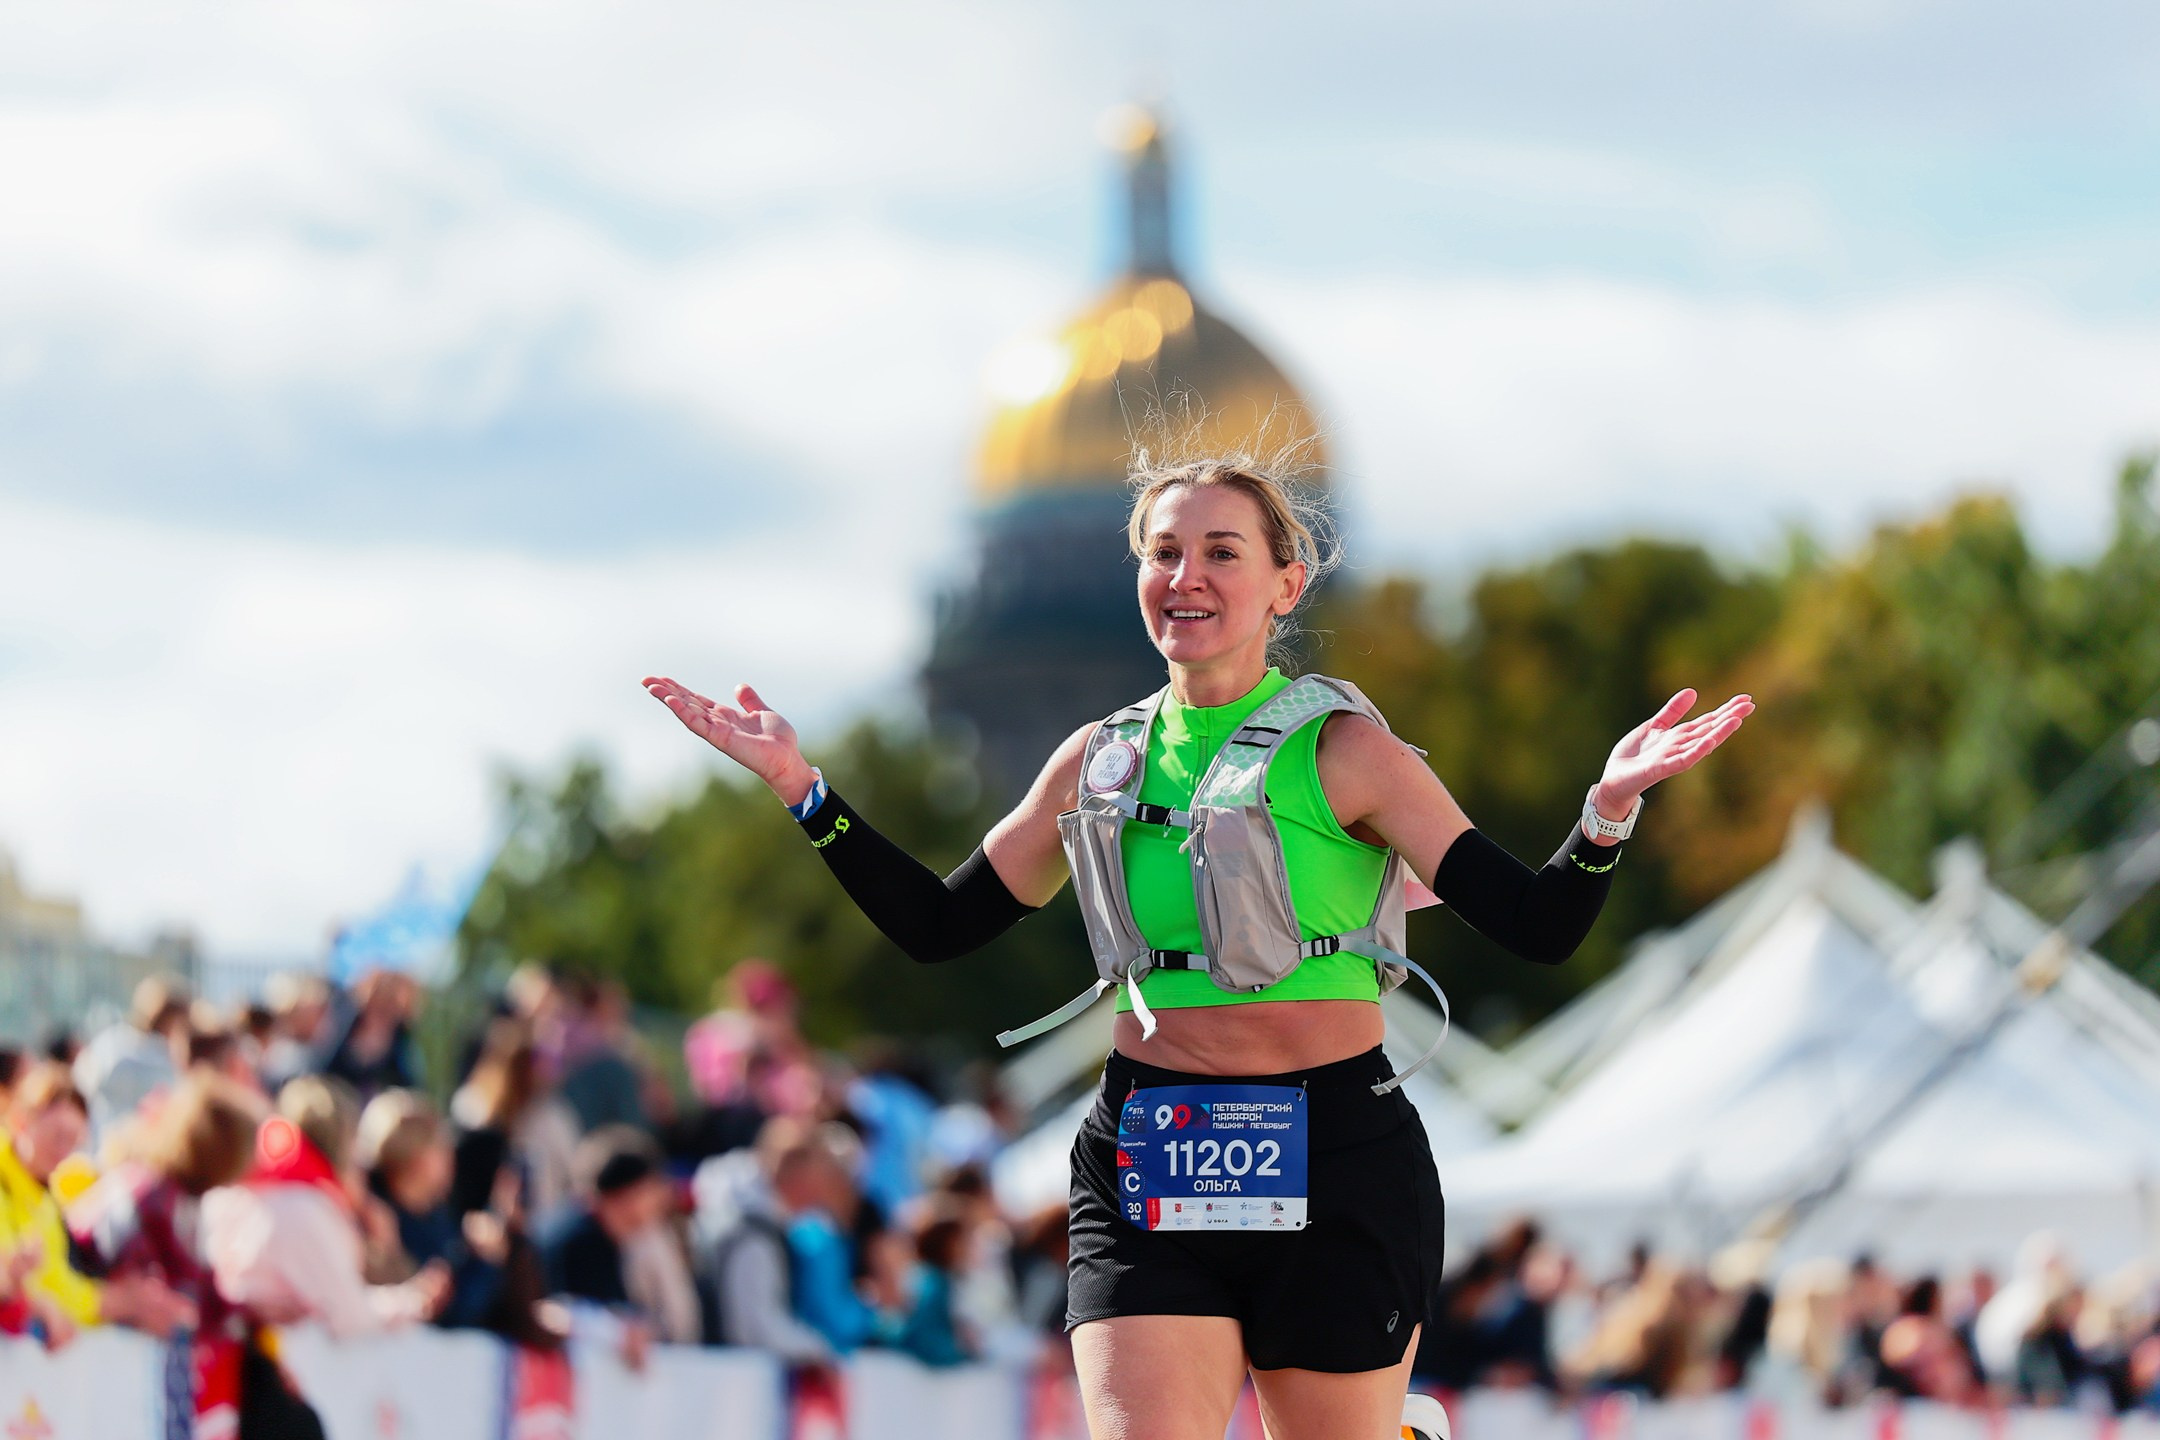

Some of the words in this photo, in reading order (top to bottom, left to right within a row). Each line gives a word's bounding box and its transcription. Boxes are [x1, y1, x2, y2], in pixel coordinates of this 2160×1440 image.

[1212, 1102, 1293, 1113] ПЕТЕРБУРГСКИЙ
[1212, 1113, 1262, 1121] МАРАФОН
[1250, 1122, 1292, 1130] ПЕТЕРБУРГ
[1163, 1139, 1281, 1176] 11202
[1193, 1180, 1242, 1192] ОЛЬГА
[1127, 1202, 1142, 1214] 30
